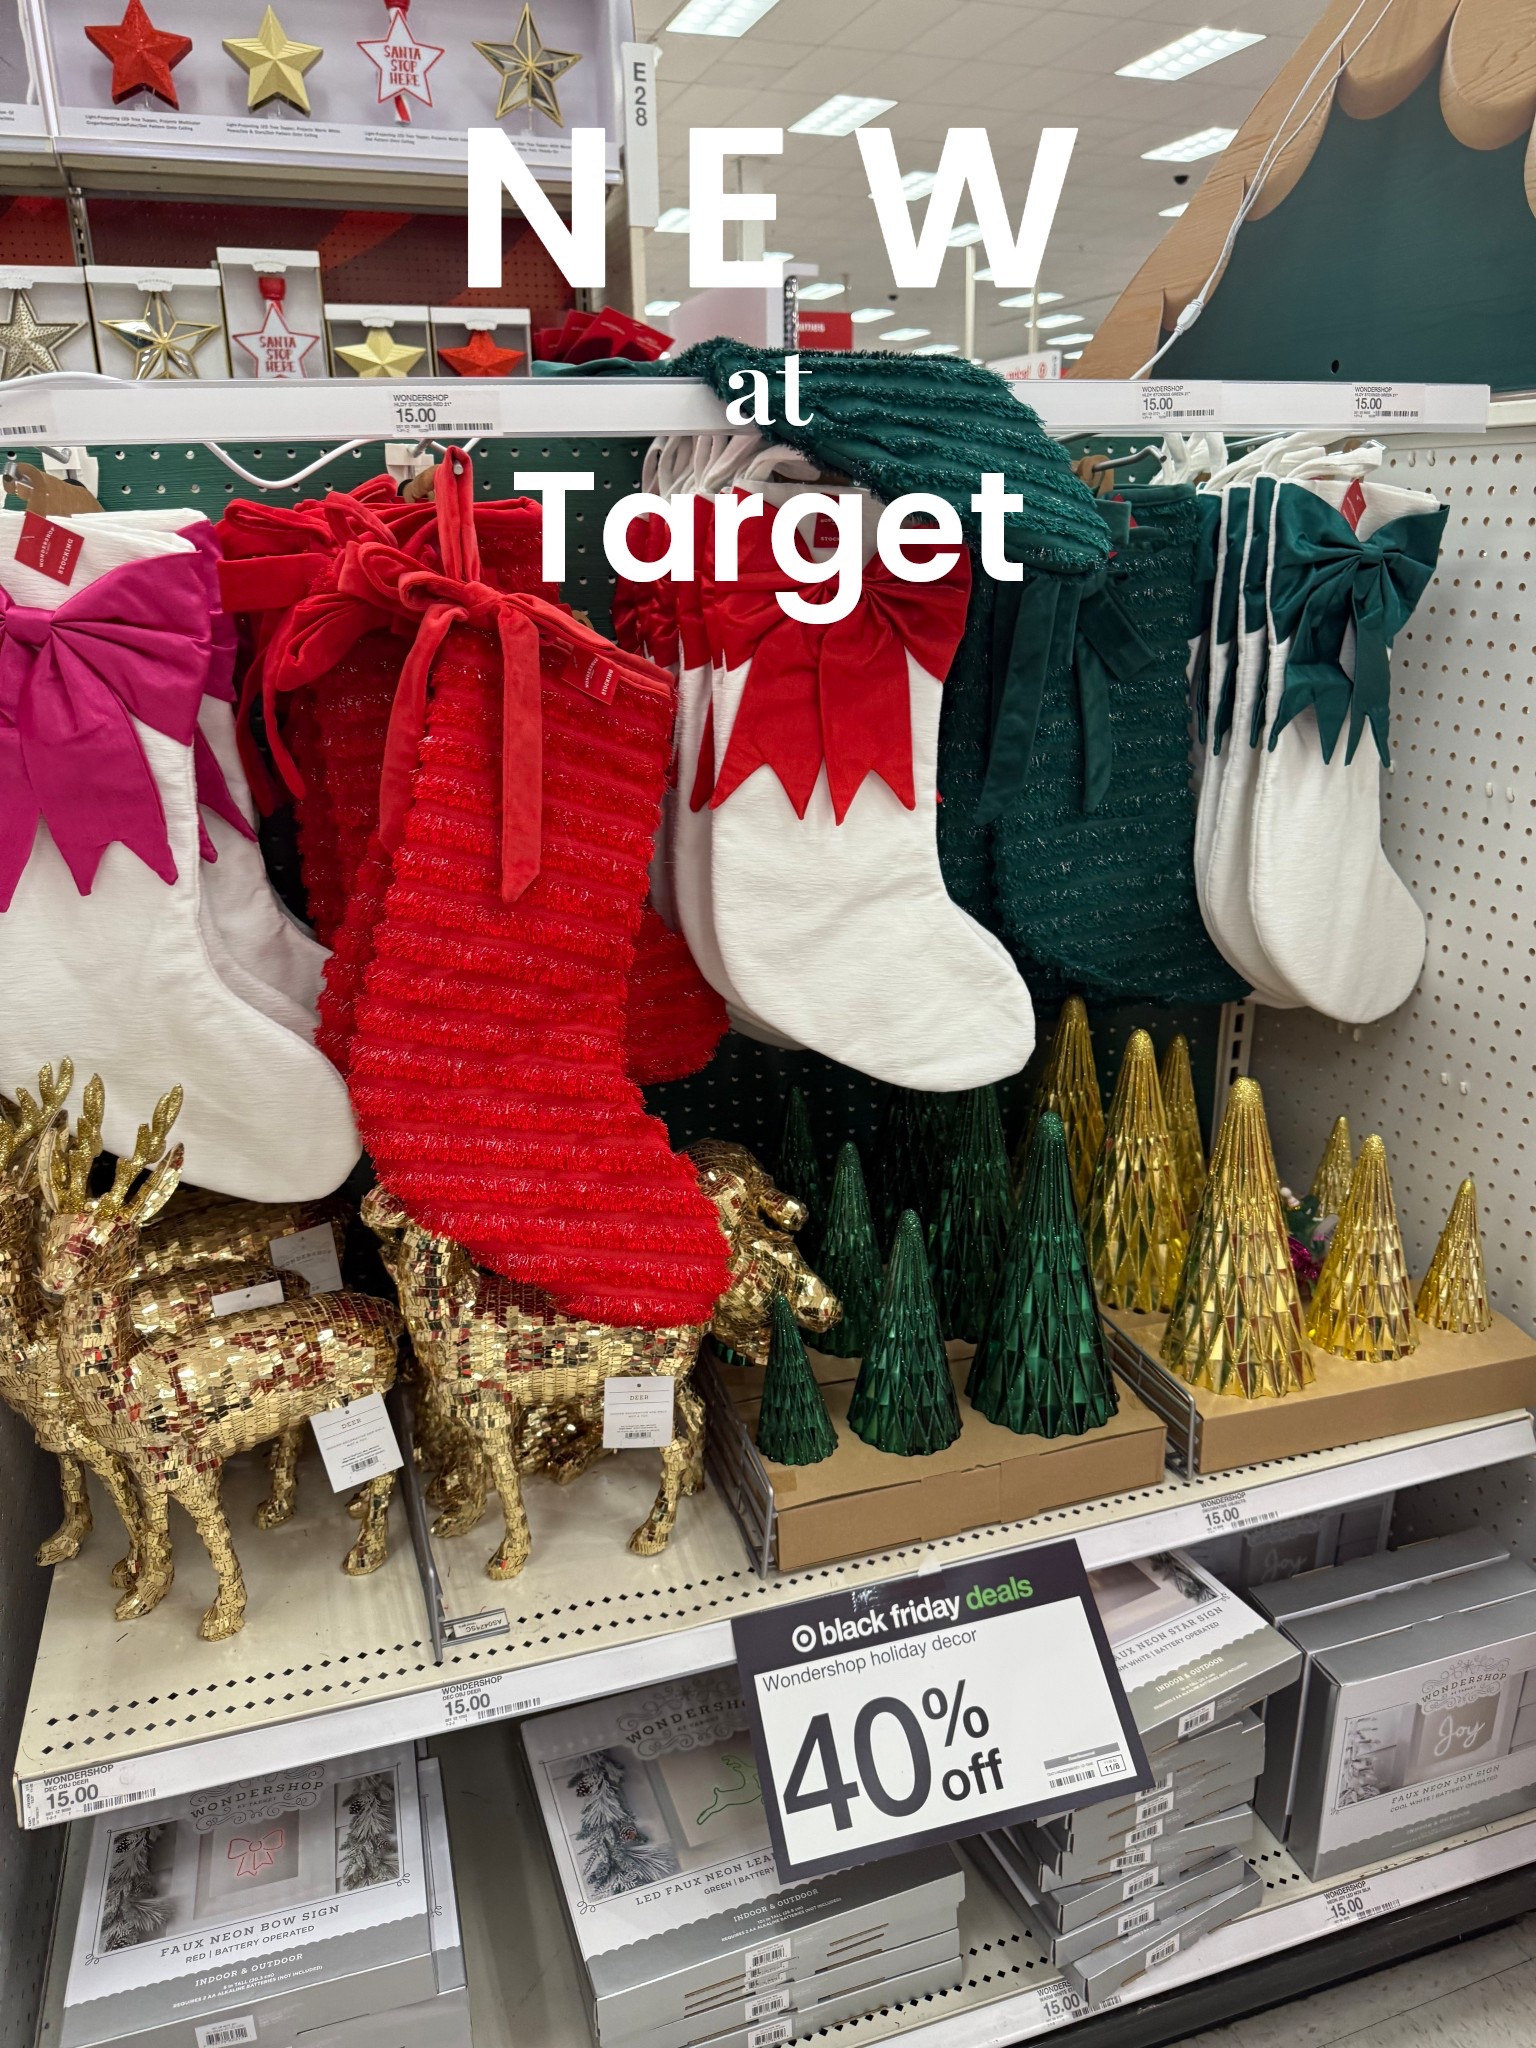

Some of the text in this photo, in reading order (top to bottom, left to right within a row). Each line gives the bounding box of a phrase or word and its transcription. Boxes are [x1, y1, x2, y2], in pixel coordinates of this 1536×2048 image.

[384, 45, 421, 60] SANTA
[391, 60, 417, 72] STOP
[390, 72, 420, 87] HERE
[259, 336, 296, 348] SANTA
[267, 349, 290, 360] STOP
[266, 361, 296, 373] HERE
[393, 394, 448, 402] WONDERSHOP
[1142, 385, 1184, 393] WONDERSHOP
[396, 408, 436, 422] 15.00
[1143, 397, 1173, 411] 15.00
[1355, 397, 1382, 410] 15.00
[40, 526, 55, 568] WONDERSHOP
[58, 538, 74, 574] STOCKING
[601, 668, 614, 696] STOCKING
[341, 1418, 362, 1429] DEER
[1200, 1492, 1246, 1509] WONDERSHOP
[1205, 1507, 1240, 1526] 15.00
[819, 1576, 1034, 1645] black friday deals
[1113, 1606, 1224, 1662] AUX NEON STAR SIGN
[1128, 1653, 1152, 1667] WHITE
[1154, 1638, 1184, 1657] BATTERY
[1184, 1621, 1220, 1640] OPERATED
[763, 1628, 977, 1692] Wondershop holiday decor
[441, 1675, 503, 1695] WONDERSHOP
[1155, 1676, 1184, 1693] INDOOR
[1190, 1656, 1224, 1675] OUTDOOR
[1422, 1673, 1507, 1703] WONDERSHOP
[445, 1693, 491, 1716] 15.00
[626, 1699, 746, 1744] WONDERSH
[1434, 1714, 1486, 1757] Joy
[43, 1764, 114, 1787] WONDERSHOP
[44, 1778, 89, 1793] DEC OBJ DEER
[942, 1747, 1004, 1801] off
[1391, 1764, 1501, 1804] FAUX NEON JOY SIGN
[46, 1784, 99, 1810] 15.00
[190, 1781, 324, 1818] WONDERSHOP
[1390, 1803, 1408, 1813] COOL
[1409, 1796, 1431, 1806] WHITE
[1435, 1786, 1464, 1799] BATTERY
[635, 1853, 775, 1906] LED FAUX NEON LEA
[704, 1866, 776, 1895] GREEN BATTERY
[1324, 1880, 1367, 1900] WONDERSHOP
[733, 1906, 768, 1923] INDOOR
[777, 1888, 819, 1907] OUTDOOR
[1330, 1897, 1364, 1918] 15.00
[160, 1904, 340, 1958] FAUX NEON BOW SIGN
[185, 1925, 315, 1964] RED BATTERY OPERATED
[195, 1953, 303, 1987] INDOOR & OUTDOOR
[1037, 1980, 1072, 1997] WONDERS
[1044, 1993, 1080, 2017] 15.00
